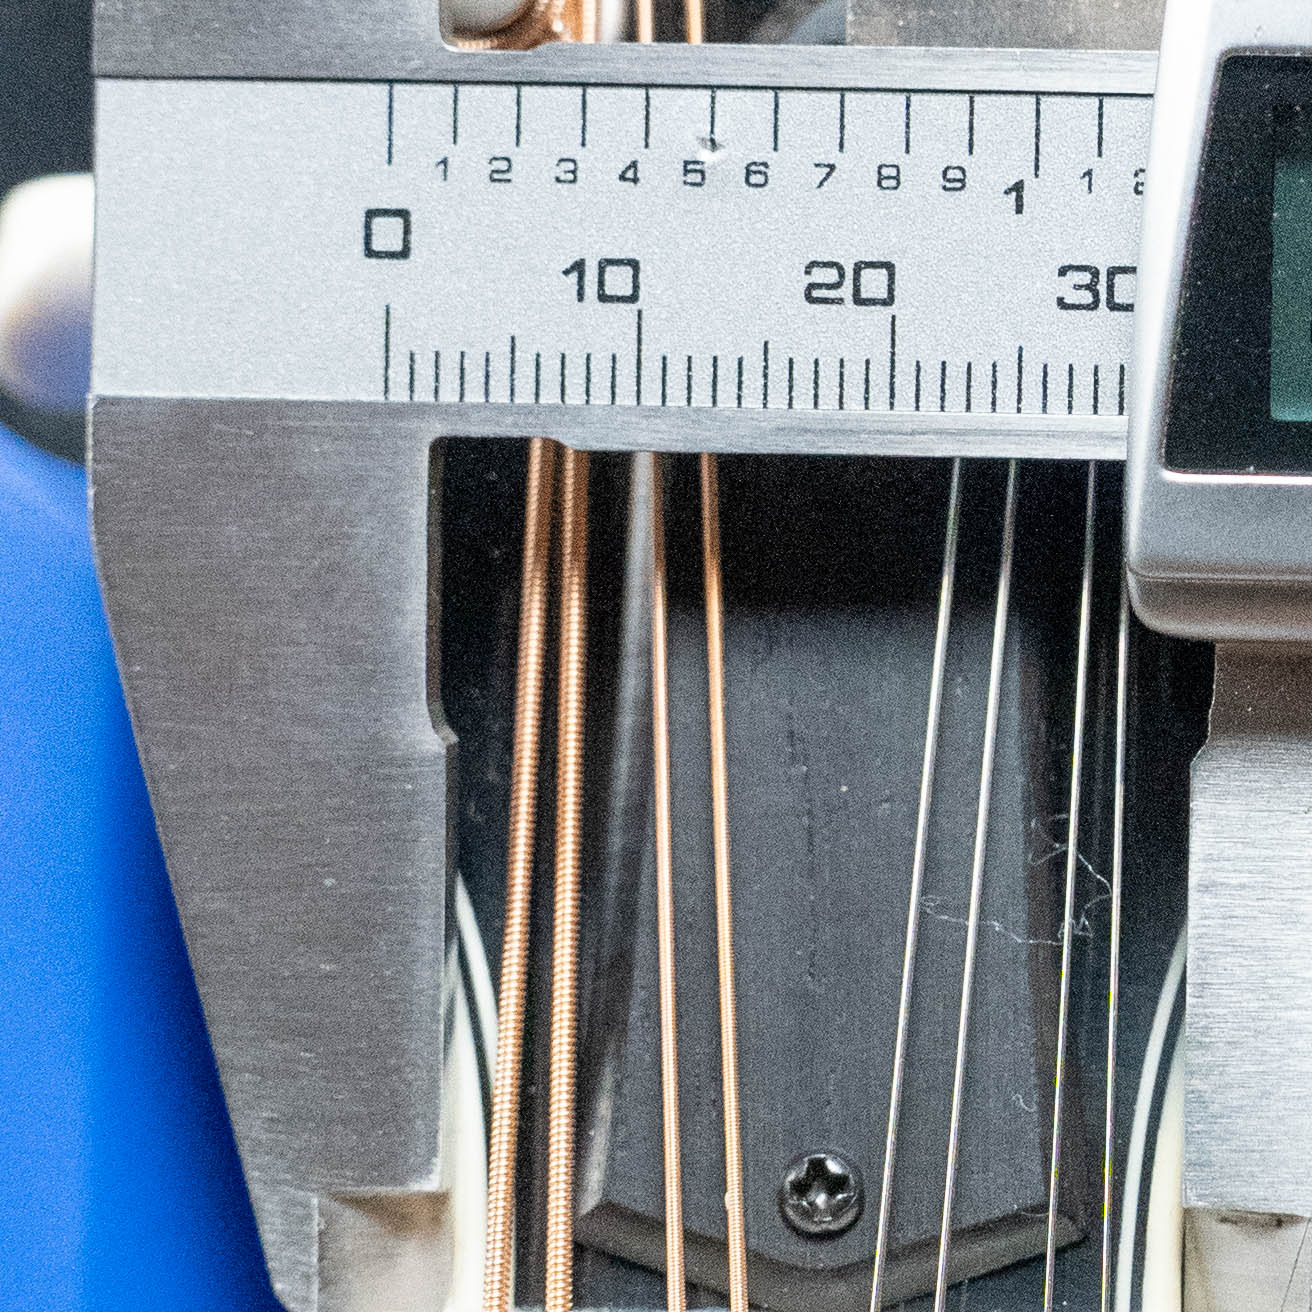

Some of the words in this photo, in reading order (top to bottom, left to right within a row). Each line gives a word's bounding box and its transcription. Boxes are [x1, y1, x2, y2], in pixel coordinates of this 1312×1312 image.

[435, 156, 449, 182] 1
[488, 156, 513, 184] 2
[554, 157, 579, 185] 3
[618, 159, 640, 186] 4
[682, 159, 706, 188] 5
[744, 161, 770, 189] 6
[814, 162, 837, 189] 7
[876, 163, 901, 191] 8
[941, 165, 967, 192] 9
[1003, 178, 1025, 215] 1
[1080, 168, 1093, 194] 1
[363, 208, 412, 260] 0
[562, 257, 641, 305] 10
[804, 260, 896, 307] 20
[1056, 264, 1138, 313] 30
